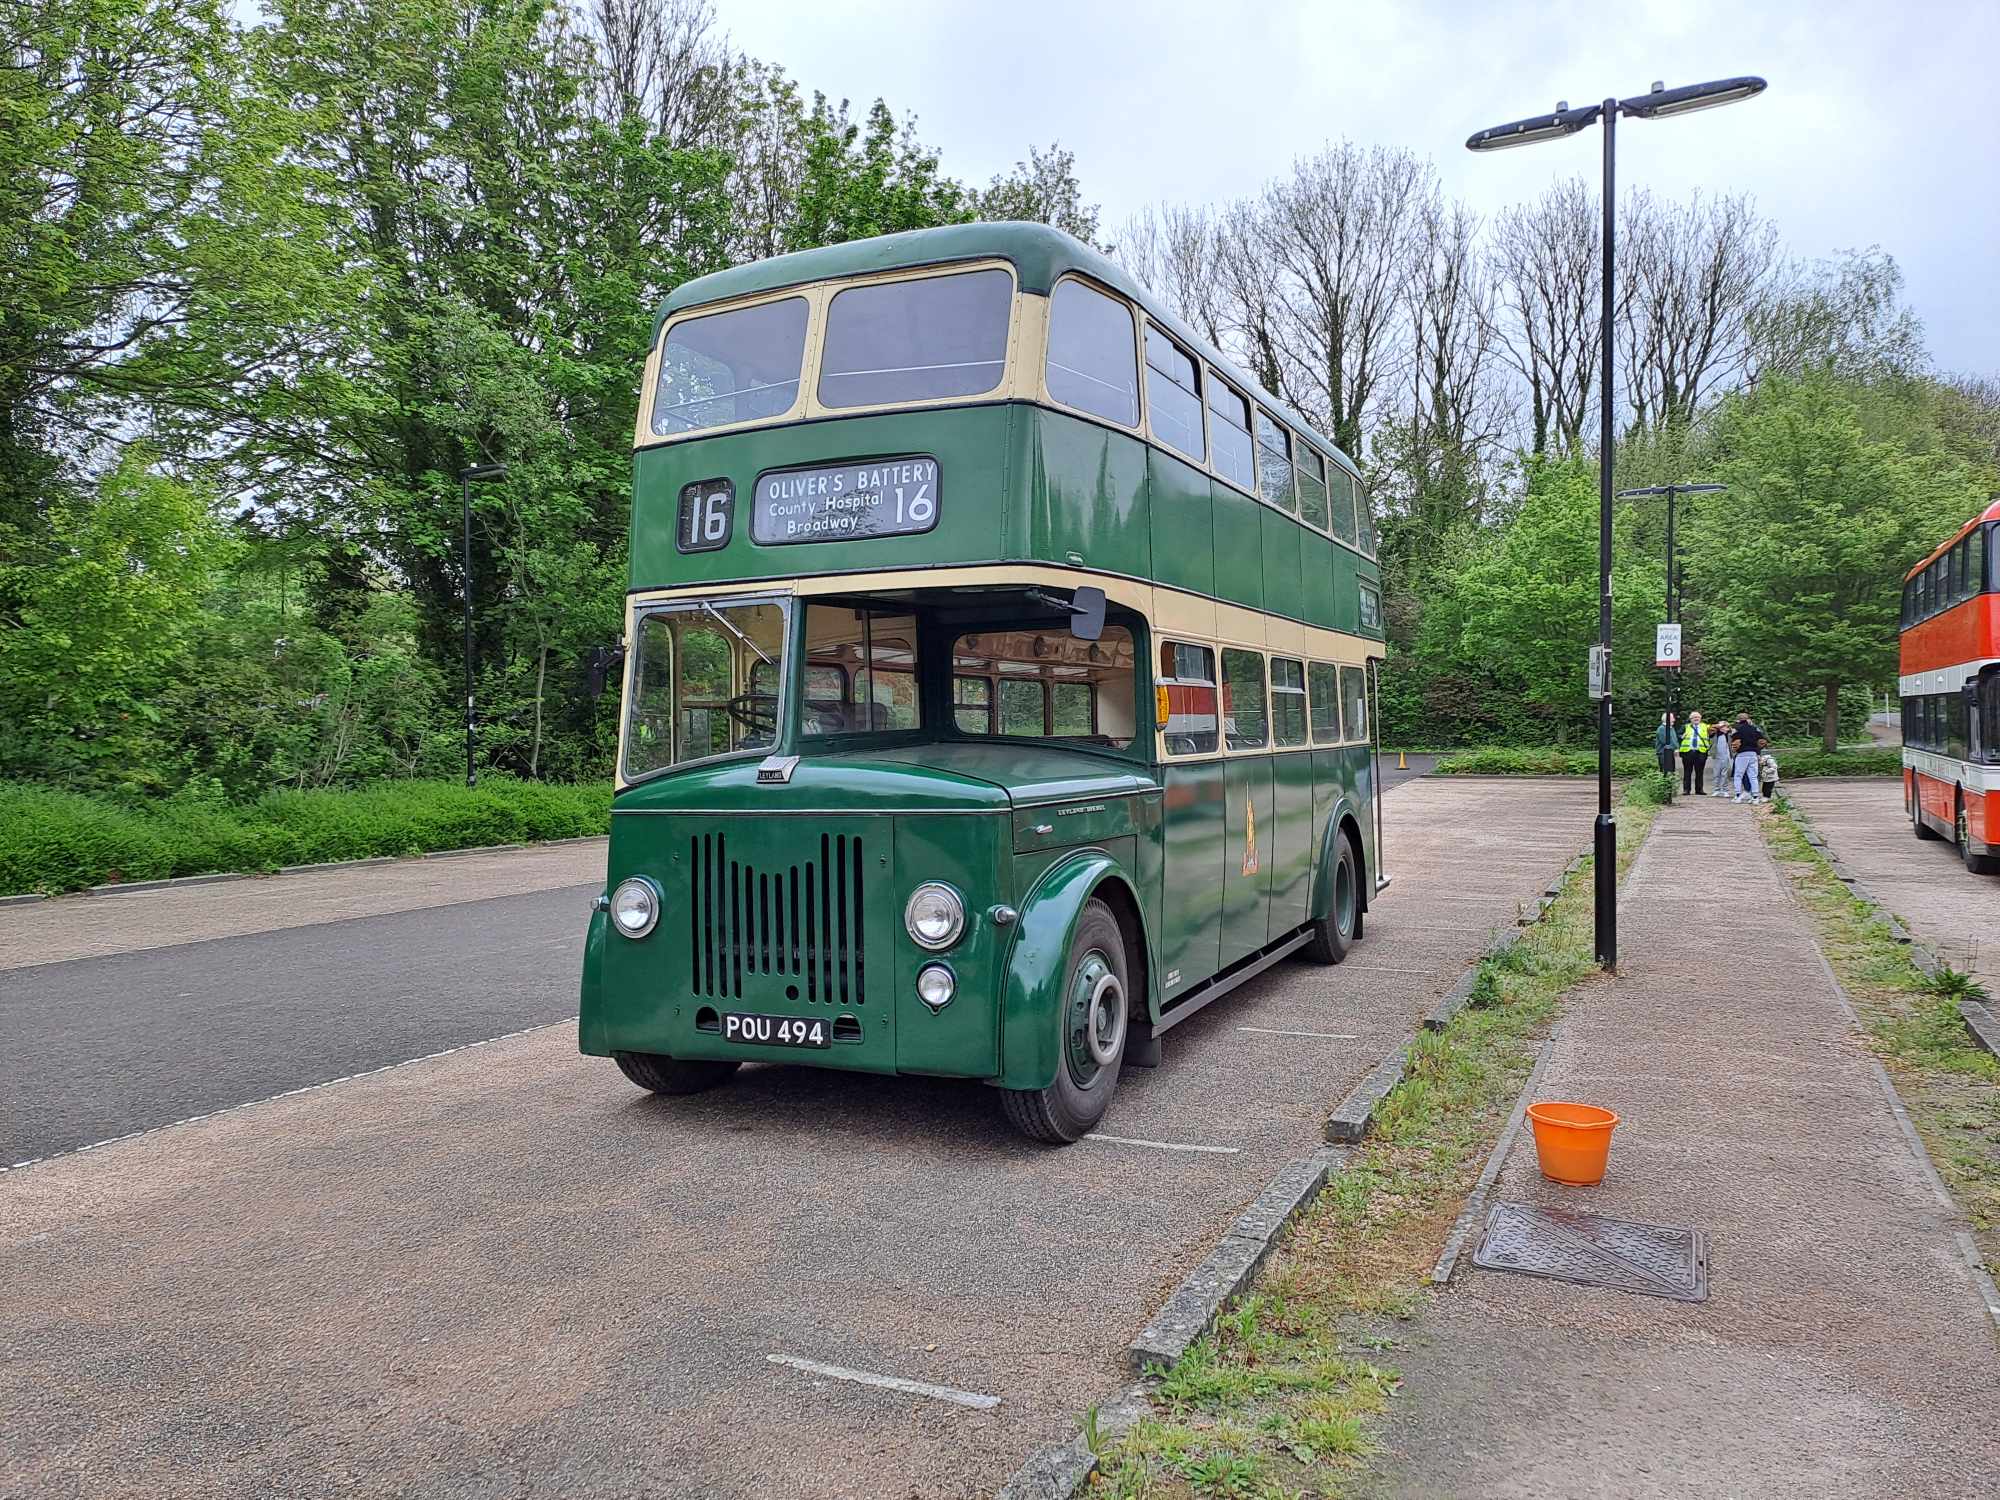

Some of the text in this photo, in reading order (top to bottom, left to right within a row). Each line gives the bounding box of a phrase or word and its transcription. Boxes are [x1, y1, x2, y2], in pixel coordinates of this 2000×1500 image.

[769, 462, 935, 499] OLIVER'S BATTERY
[769, 490, 883, 517] County Hospital
[895, 484, 933, 523] 16
[691, 493, 727, 544] 16
[787, 516, 858, 534] Broadway
[1663, 642, 1673, 656] 6
[726, 1016, 824, 1045] POU 494
